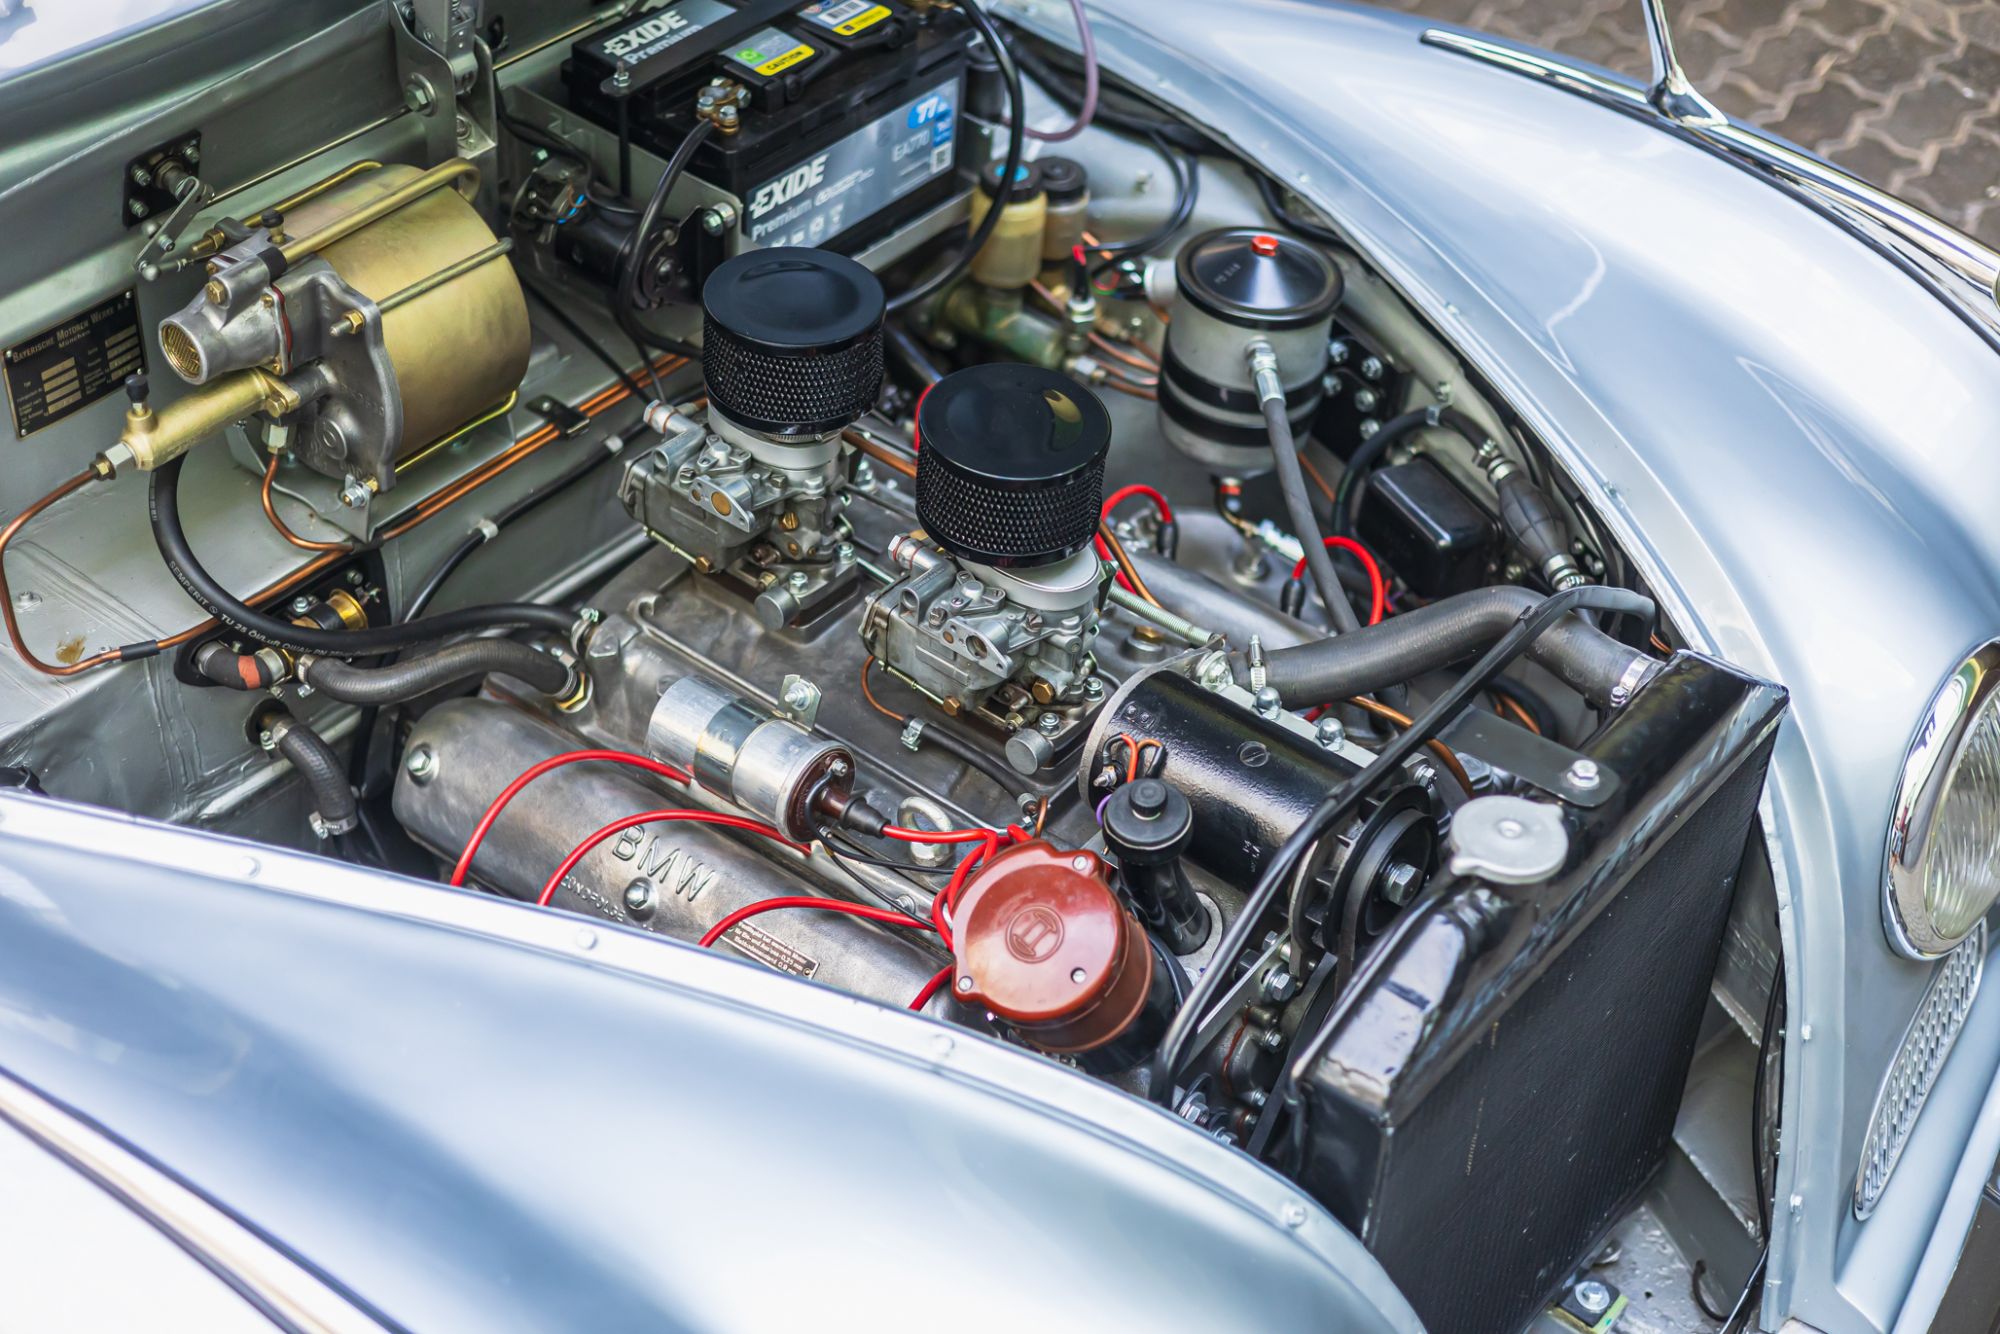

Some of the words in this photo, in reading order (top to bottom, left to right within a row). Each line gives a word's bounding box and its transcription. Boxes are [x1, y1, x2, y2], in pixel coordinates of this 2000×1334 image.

[603, 9, 688, 56] EXIDE
[622, 24, 703, 65] Premium
[892, 129, 930, 162] EA770
[749, 153, 830, 220] EXIDE
[751, 199, 812, 242] Premium
[12, 337, 55, 363] BAYERISCHE
[170, 561, 209, 605] SEMPERIT
[221, 614, 235, 626] TU
[612, 824, 716, 901] BMW
